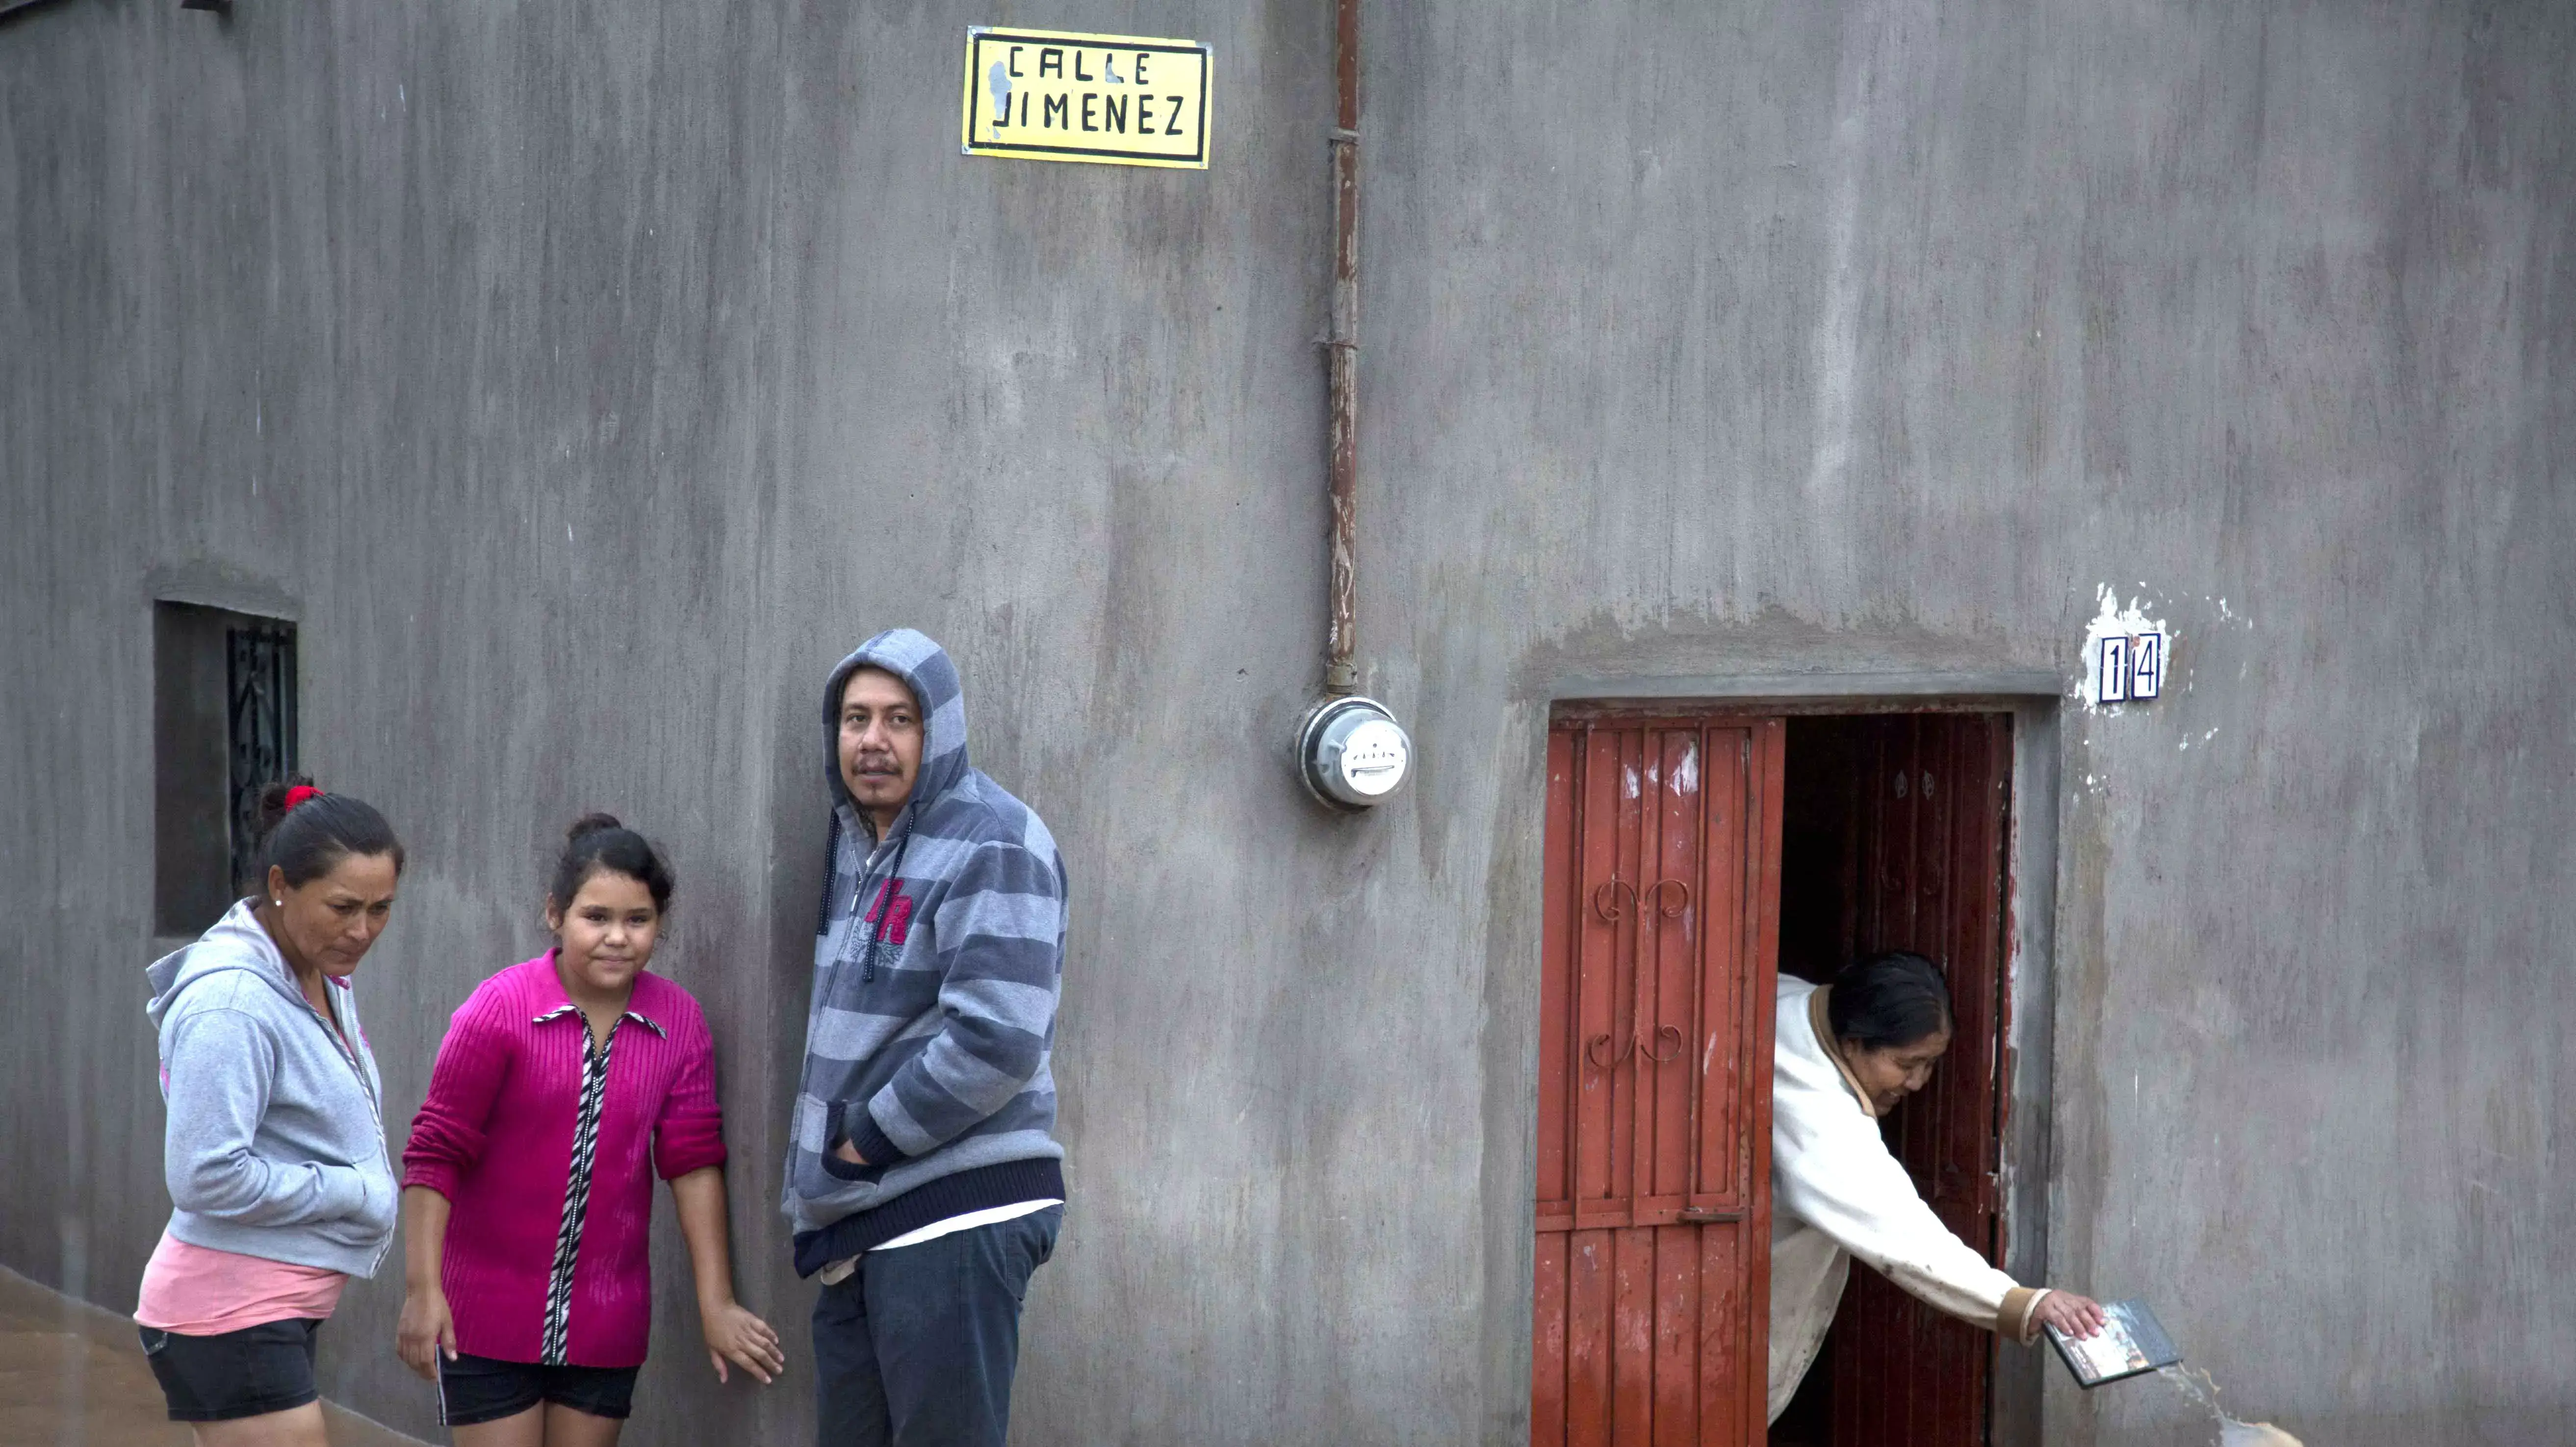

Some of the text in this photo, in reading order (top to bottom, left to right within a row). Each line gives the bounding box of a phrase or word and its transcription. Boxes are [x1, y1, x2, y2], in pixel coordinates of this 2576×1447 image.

[1009, 46, 1150, 84] CALLE
[992, 91, 1184, 135] JIMENEZ
[2110, 640, 2155, 694] 14
